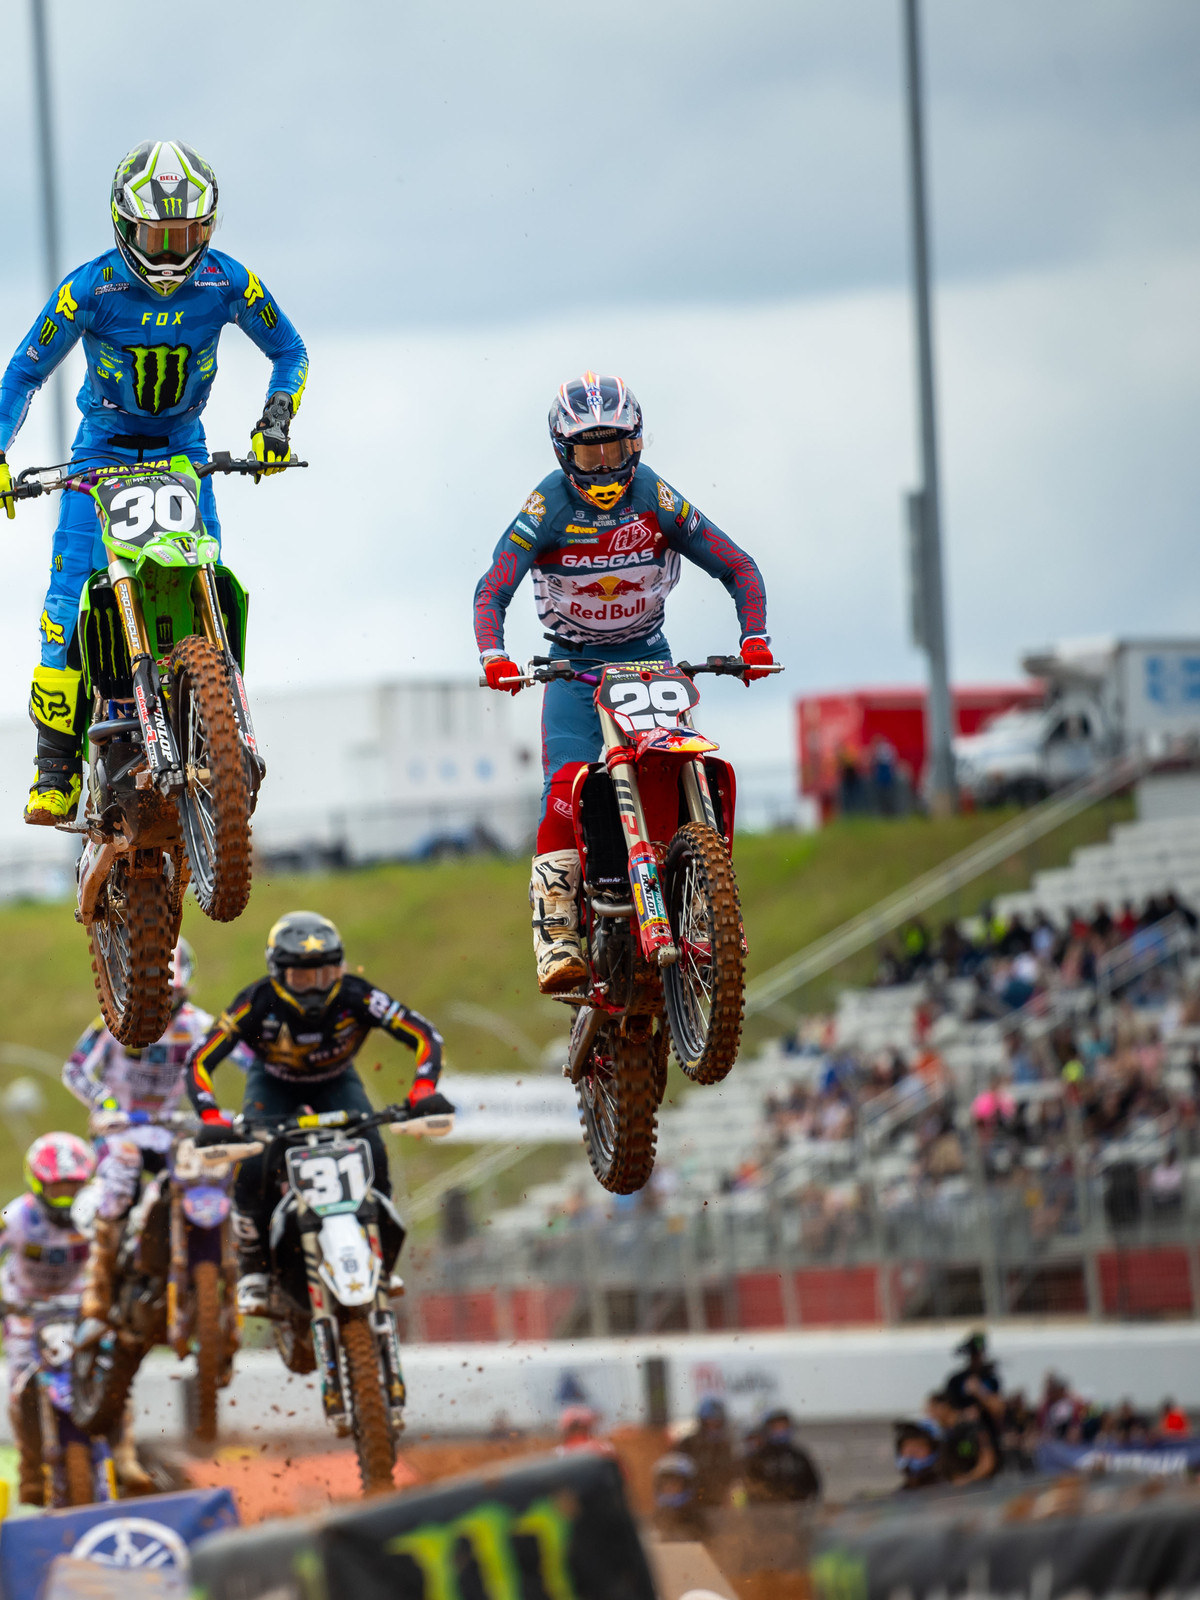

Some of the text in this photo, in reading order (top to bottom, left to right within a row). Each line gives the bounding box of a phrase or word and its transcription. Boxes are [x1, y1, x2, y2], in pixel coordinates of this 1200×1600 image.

[194, 280, 229, 288] Kawasaki
[141, 311, 184, 326] FOX
[110, 485, 197, 541] 30
[562, 547, 654, 568] GASGAS
[119, 583, 141, 650] PRO CIRCUIT
[570, 597, 646, 620] Red Bull
[609, 681, 691, 732] 29
[300, 1153, 366, 1206] 31
